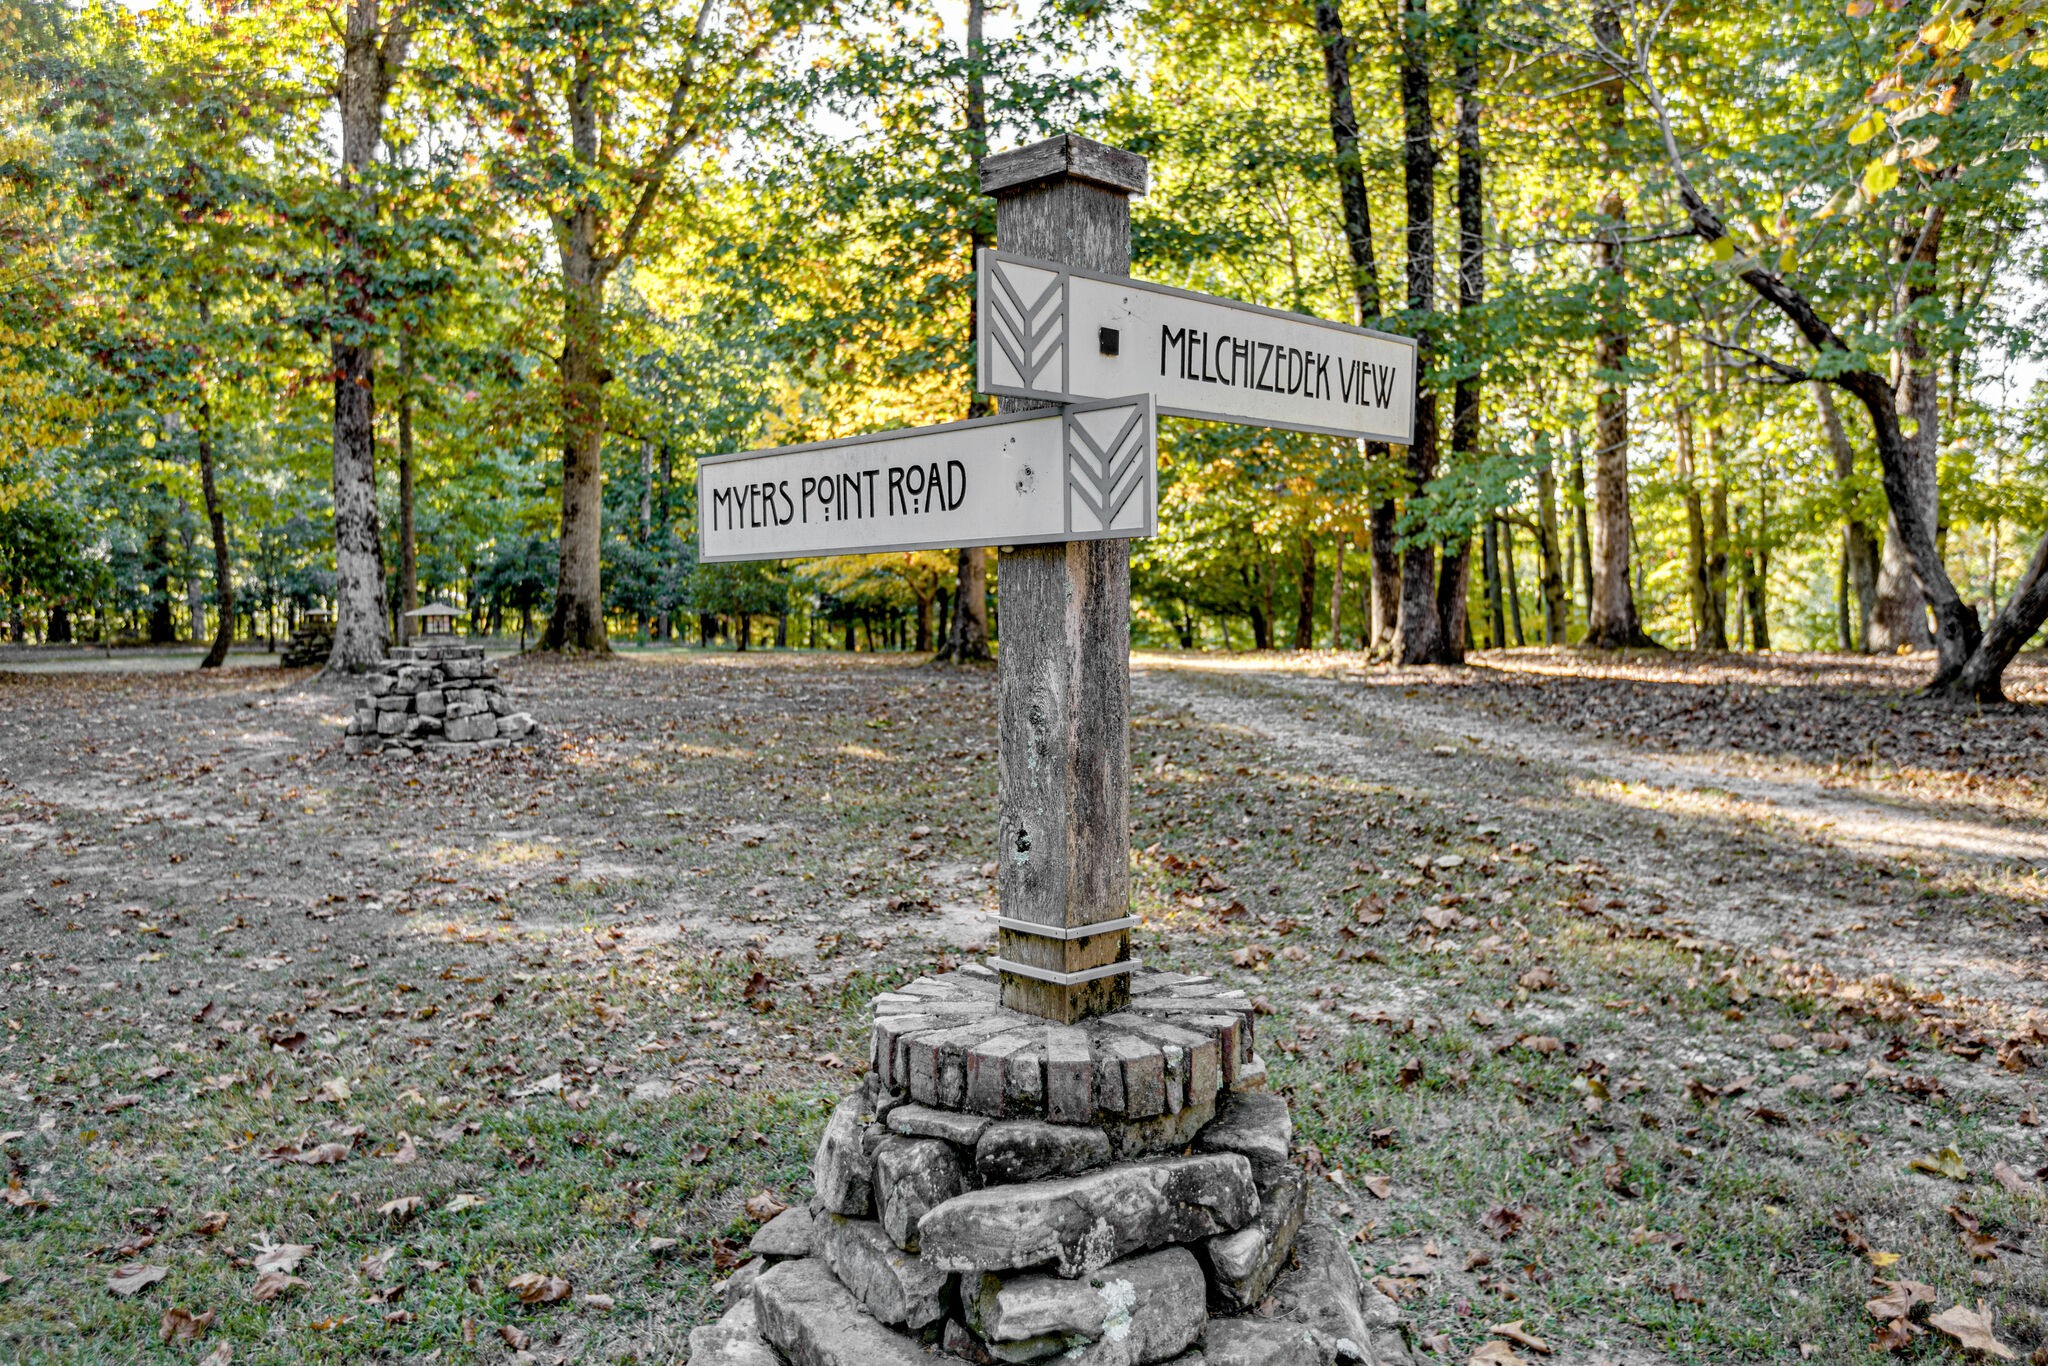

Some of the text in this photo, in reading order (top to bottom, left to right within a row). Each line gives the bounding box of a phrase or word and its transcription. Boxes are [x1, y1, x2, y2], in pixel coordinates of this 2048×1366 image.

[1161, 324, 1396, 409] MELCHIZEDEK VIEW
[712, 460, 967, 531] MYERS POINT ROAD
